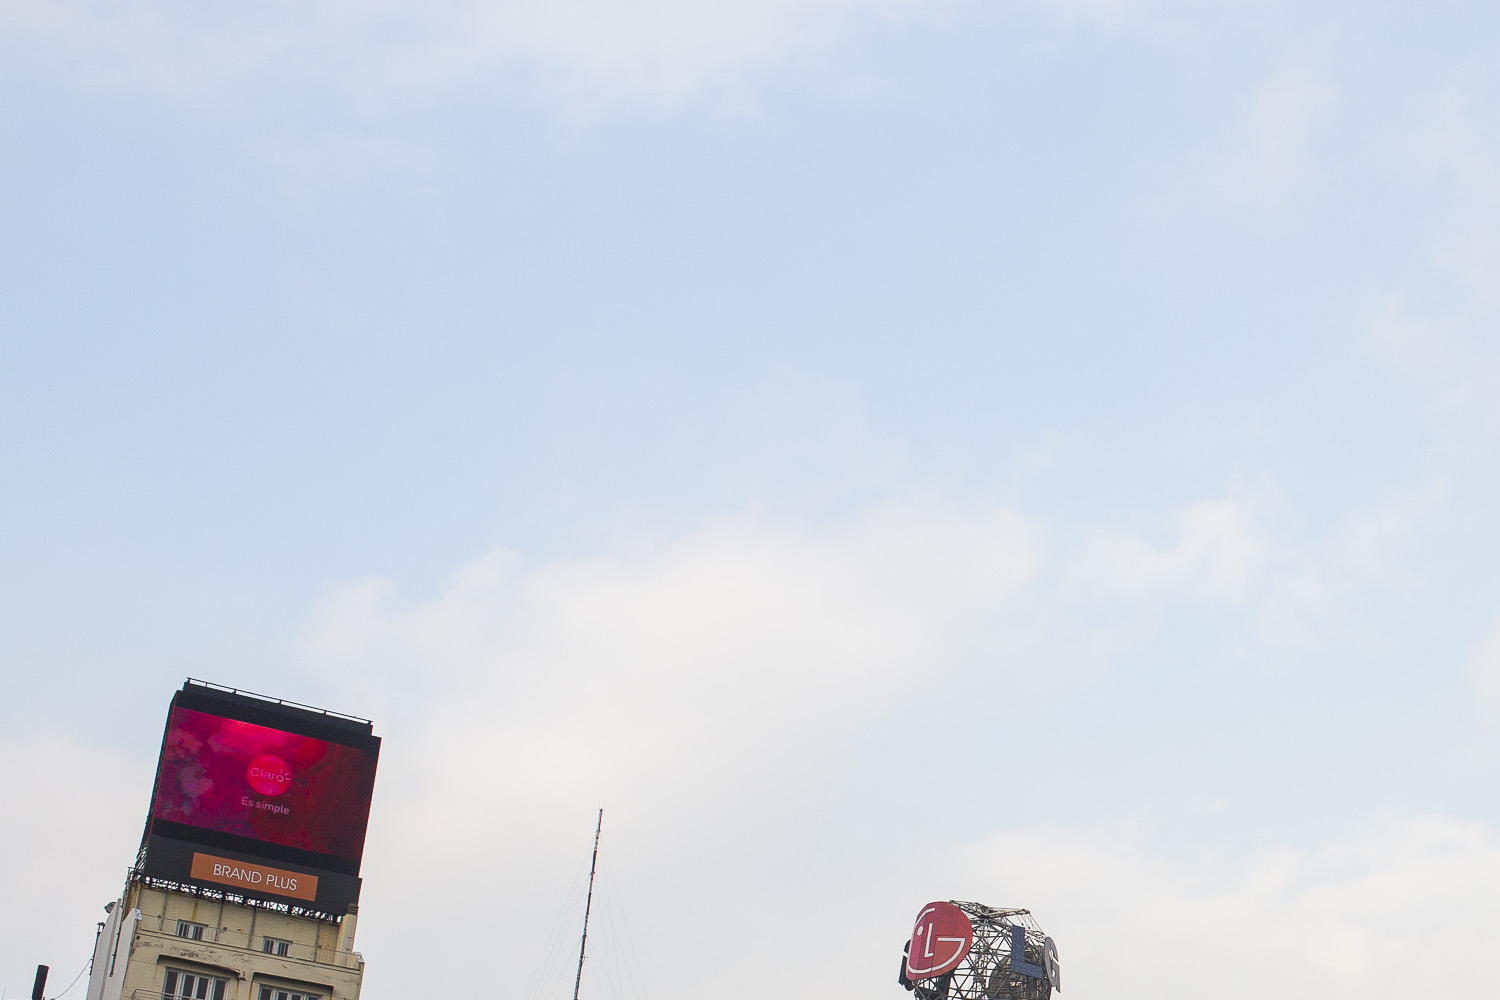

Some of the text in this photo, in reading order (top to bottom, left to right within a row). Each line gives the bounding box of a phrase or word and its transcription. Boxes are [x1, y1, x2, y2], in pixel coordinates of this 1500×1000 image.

[250, 767, 284, 782] Claro
[241, 797, 290, 815] Es simple
[213, 863, 297, 891] BRAND PLUS
